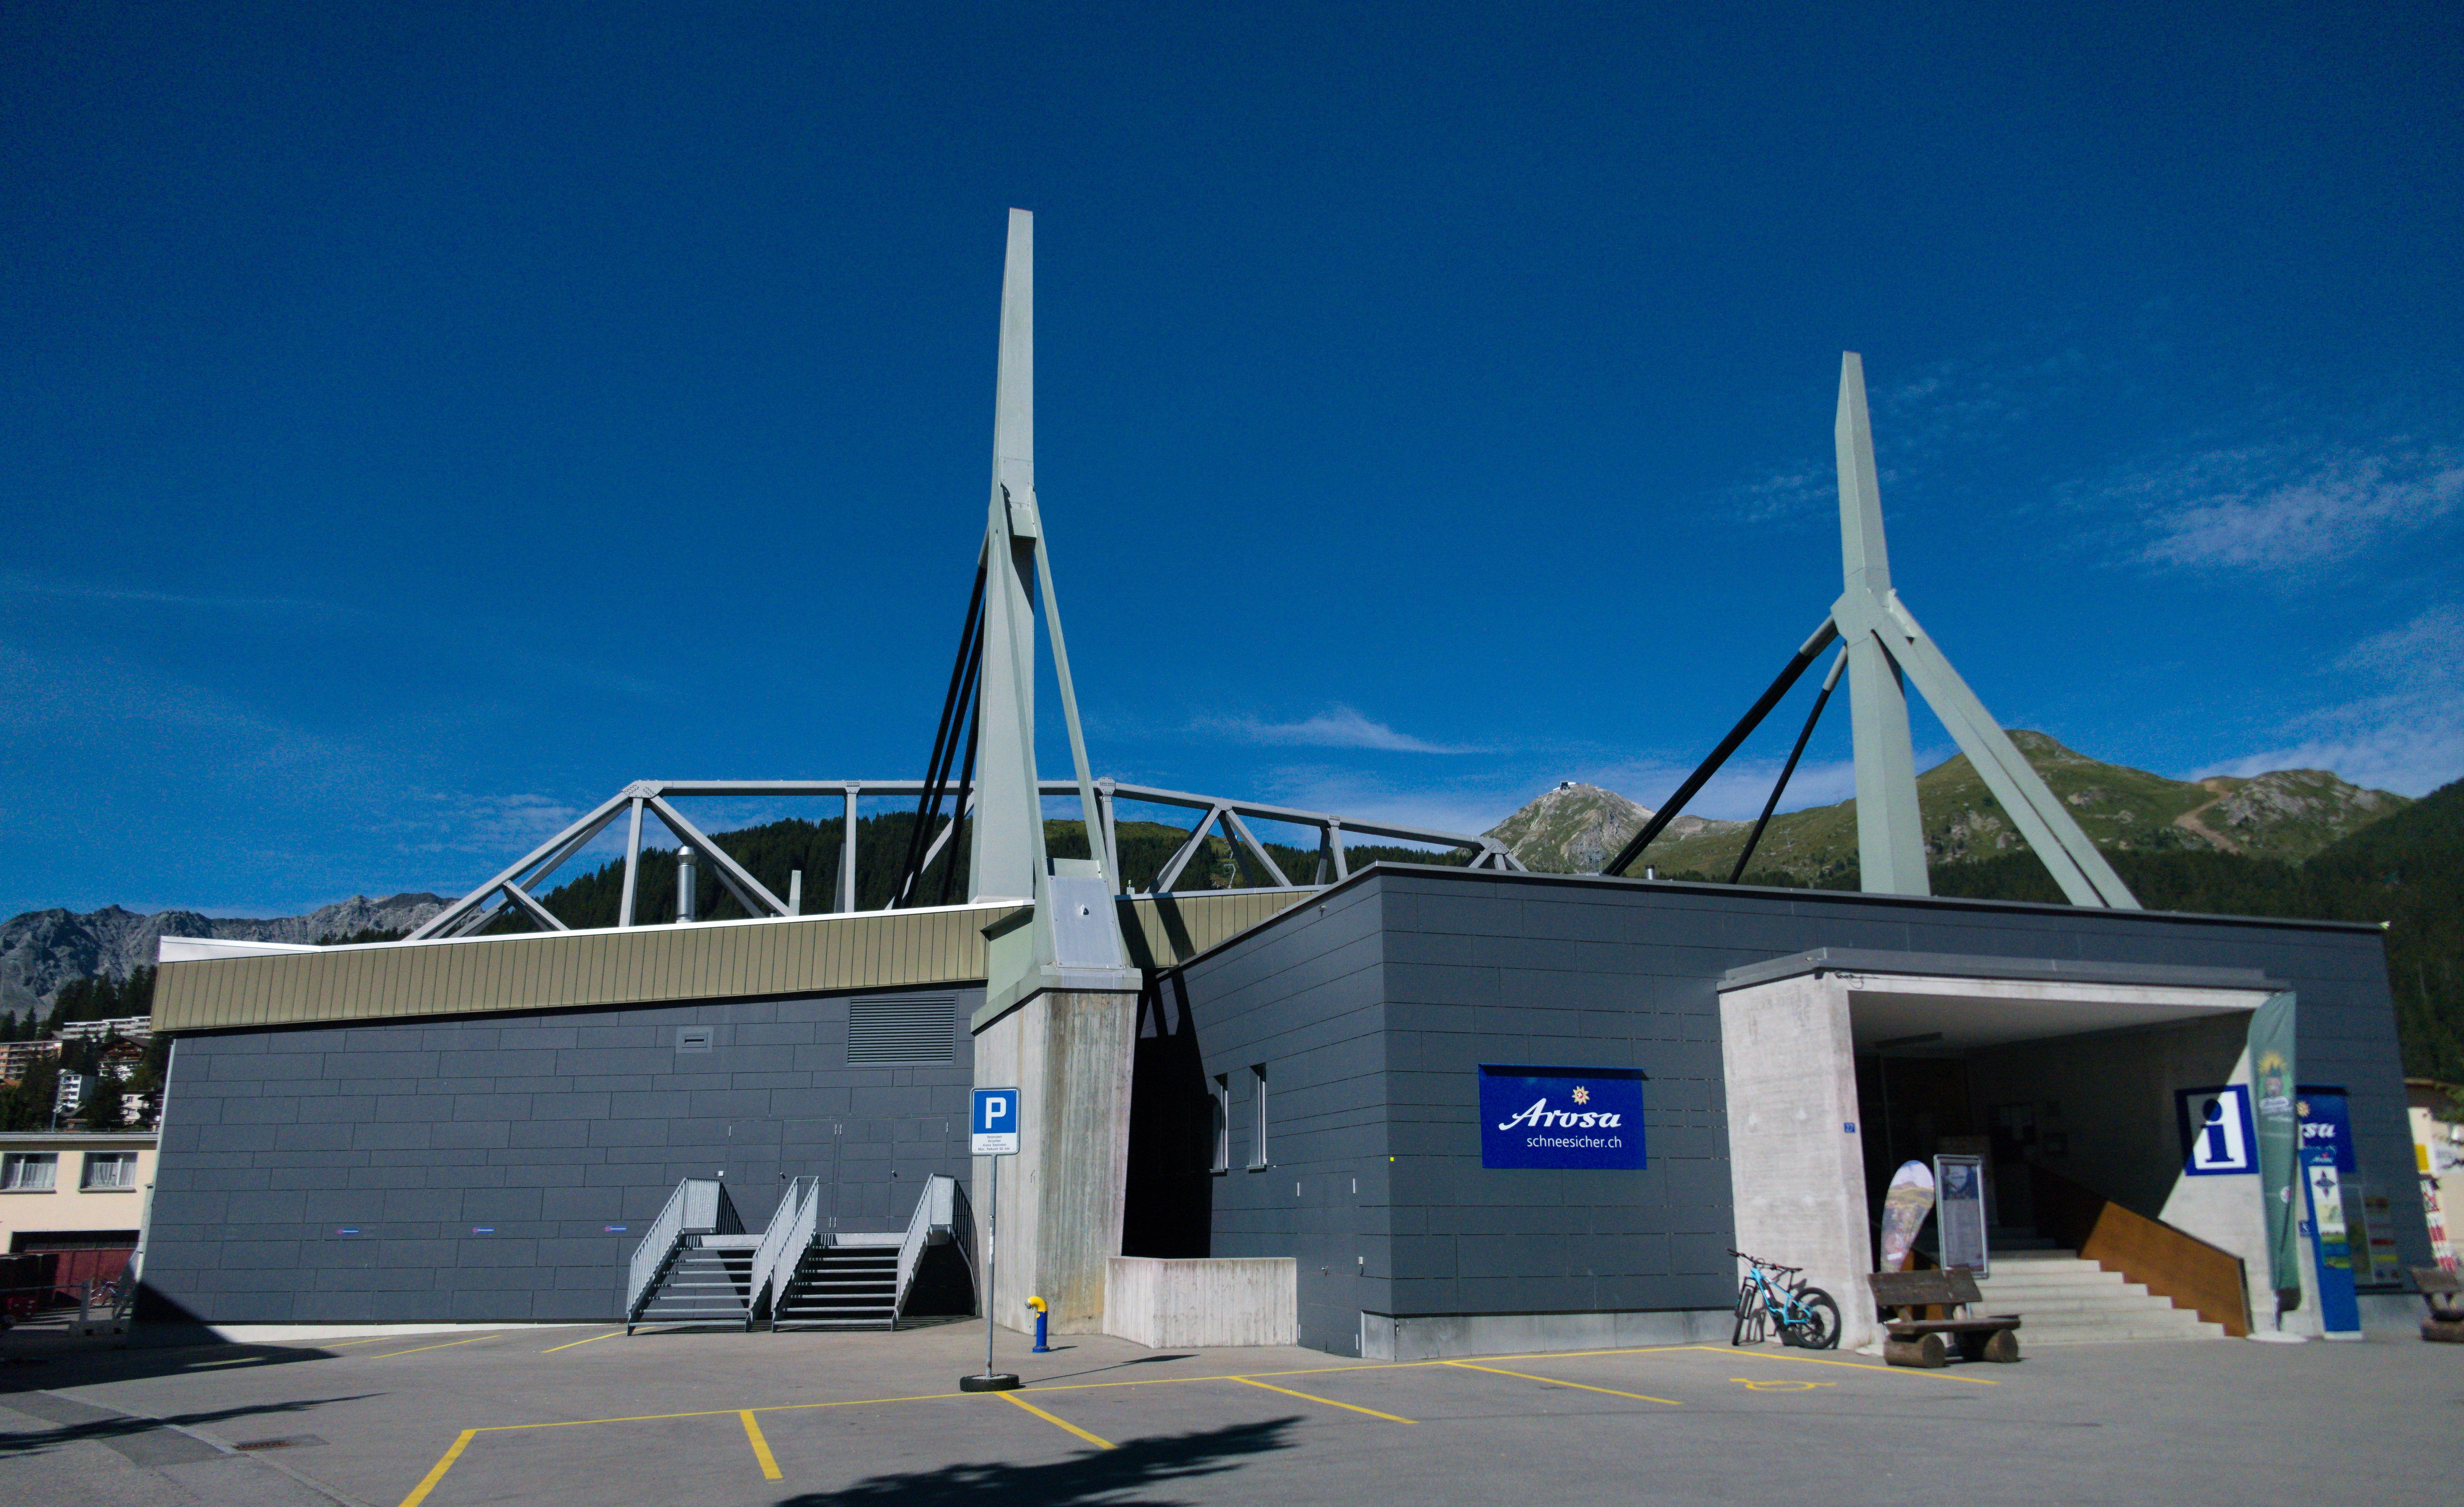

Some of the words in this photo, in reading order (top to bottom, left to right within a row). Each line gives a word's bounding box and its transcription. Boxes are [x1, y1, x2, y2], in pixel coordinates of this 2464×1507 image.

[985, 1097, 1006, 1129] P
[1498, 1098, 1621, 1131] Arosa
[1527, 1135, 1622, 1148] schneesicher.ch
